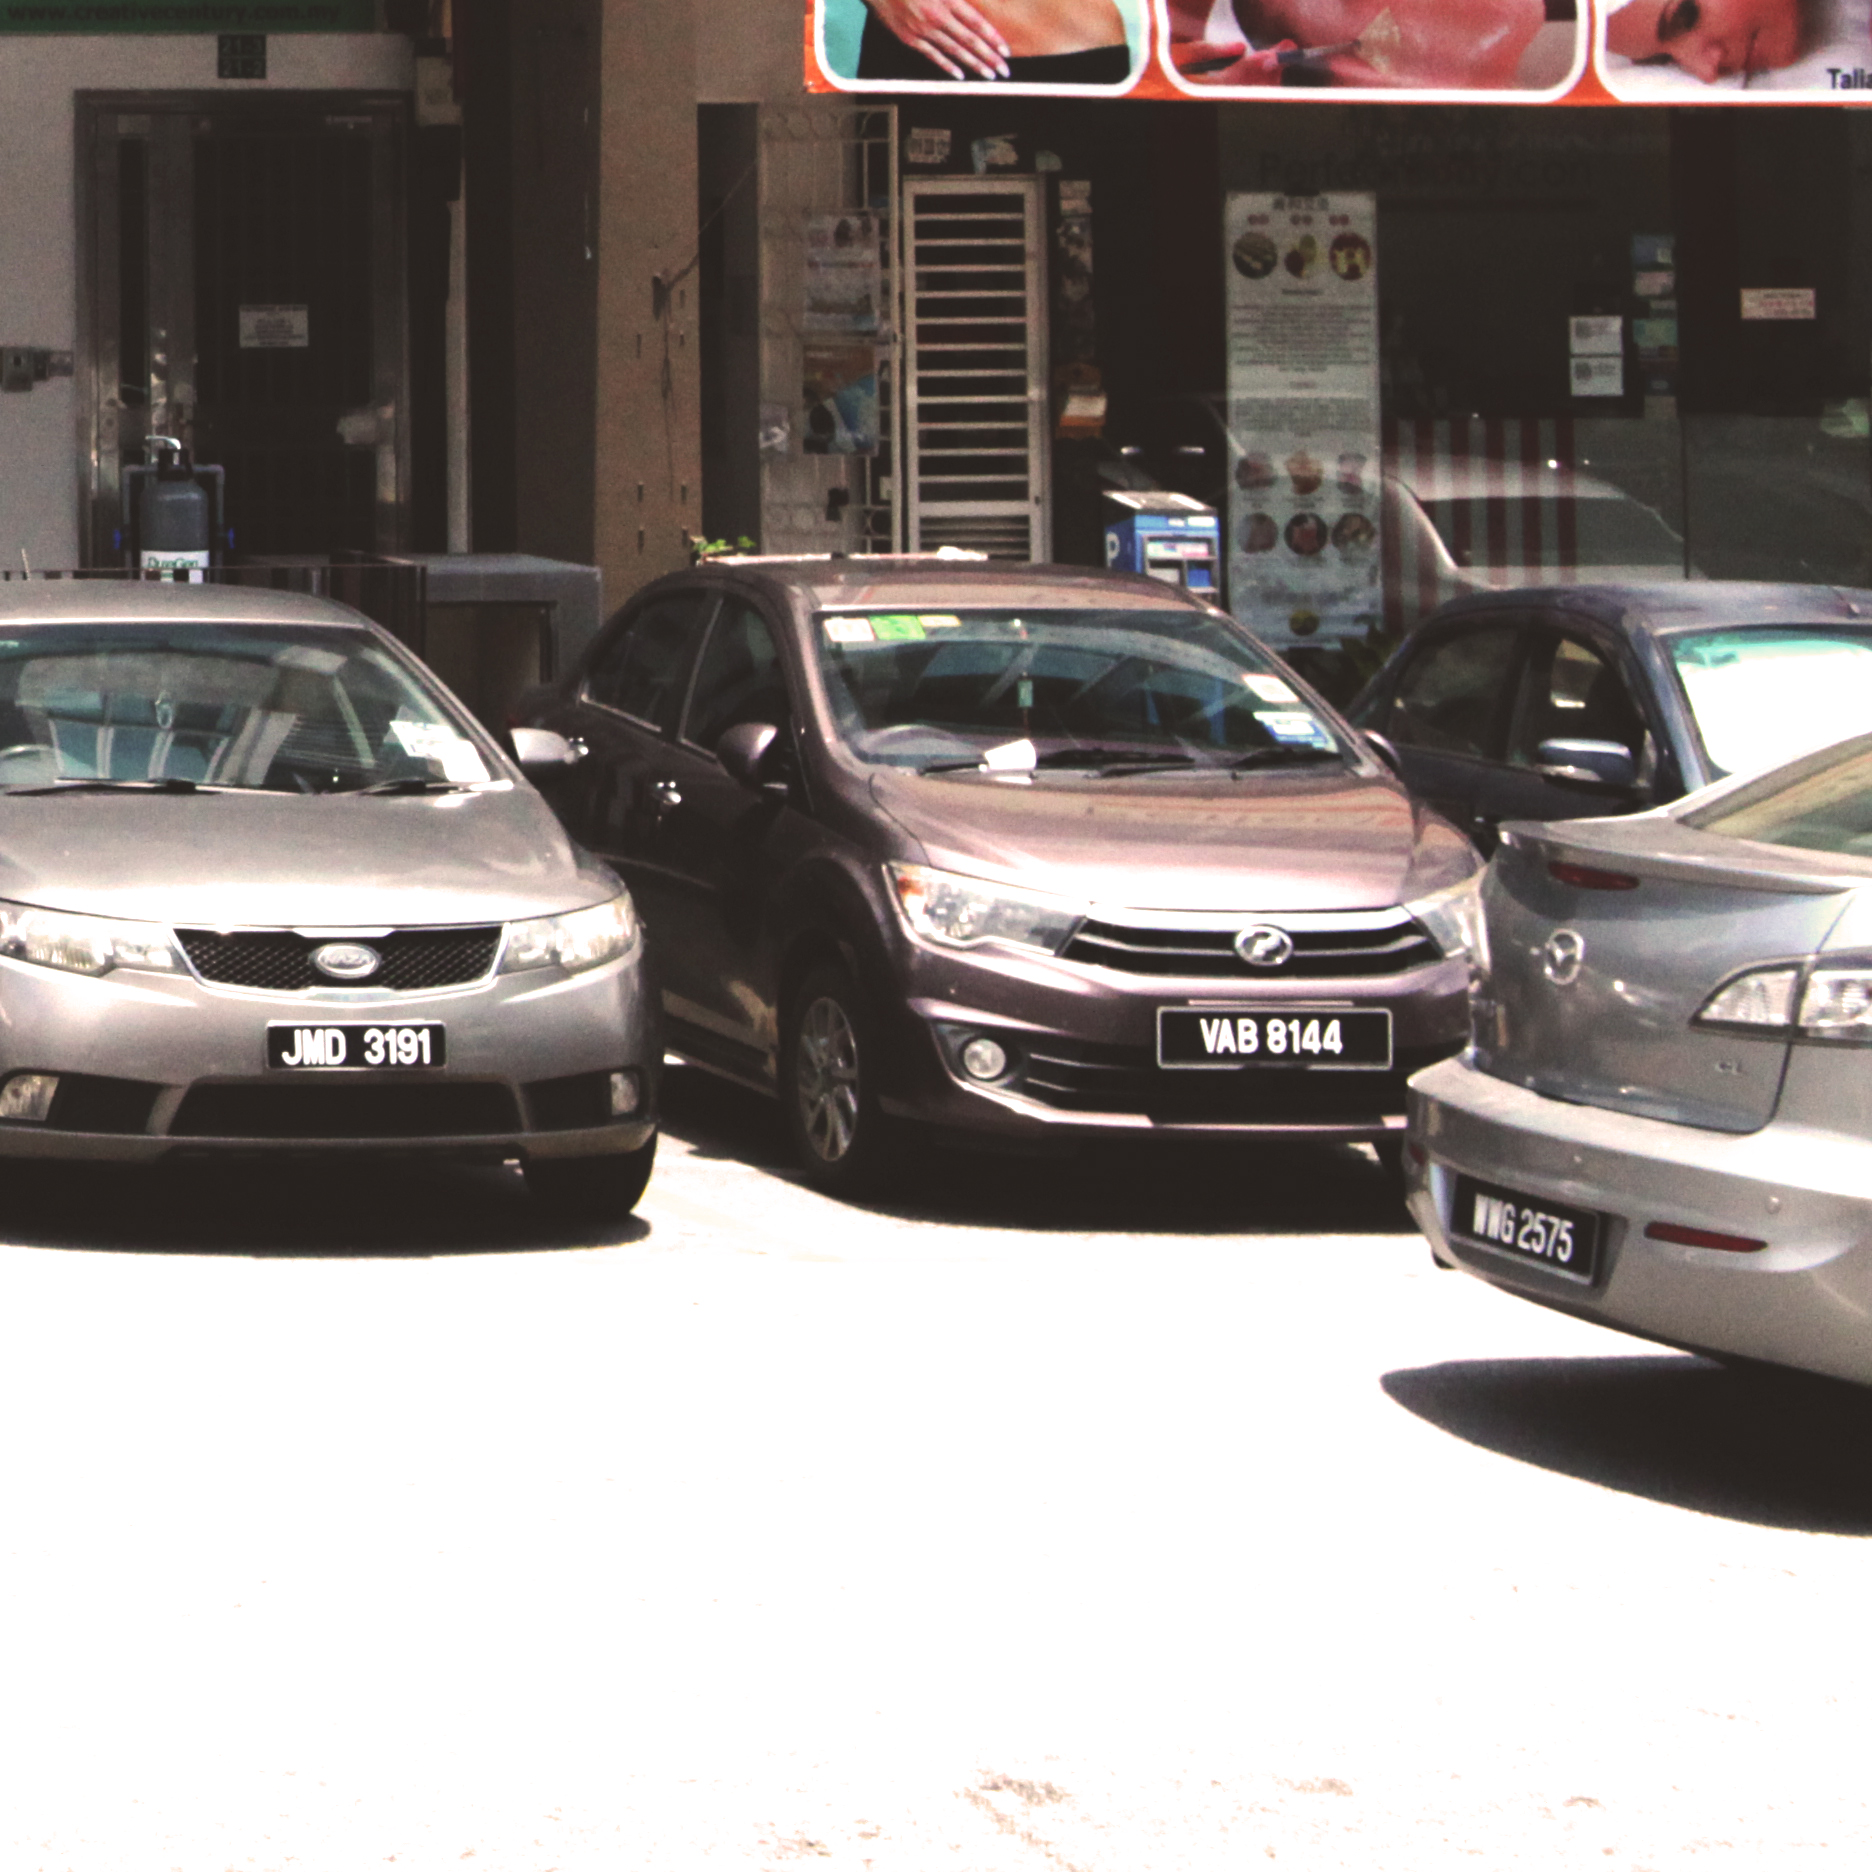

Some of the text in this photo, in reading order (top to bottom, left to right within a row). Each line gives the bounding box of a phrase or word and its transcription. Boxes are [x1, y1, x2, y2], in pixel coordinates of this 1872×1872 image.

[6, 1, 341, 27] www.creativecentury.com.my
[282, 1025, 433, 1067] JMD 3191
[1199, 1017, 1343, 1055] VAB 8144
[1517, 1206, 1575, 1265] 2575
